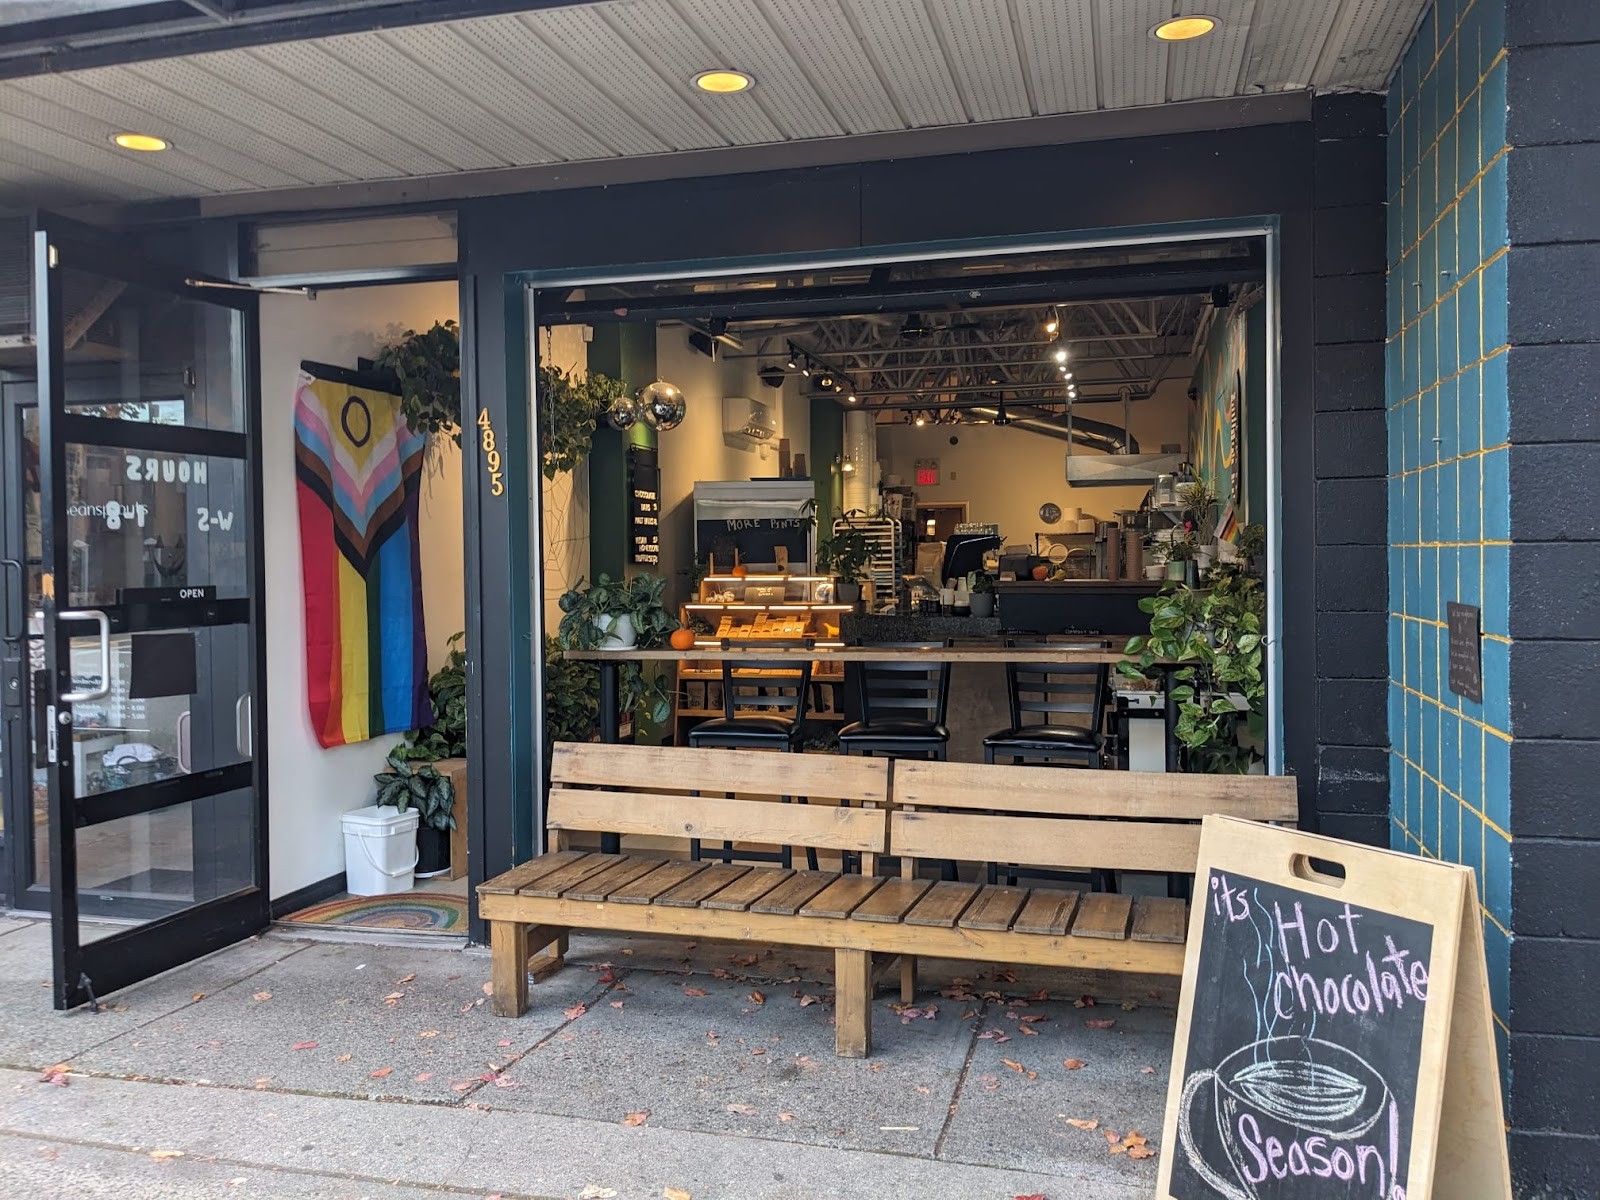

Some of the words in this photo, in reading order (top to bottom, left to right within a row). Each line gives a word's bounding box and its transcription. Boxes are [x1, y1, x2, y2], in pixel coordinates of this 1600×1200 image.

[477, 407, 504, 496] 4895
[917, 469, 937, 485] EXIT
[726, 519, 760, 532] MORE
[770, 518, 801, 530] PINTS
[180, 588, 205, 599] OPEN
[1210, 874, 1249, 922] its
[1274, 901, 1363, 964] Hot
[1274, 935, 1429, 1020] chocolate
[1238, 1101, 1408, 1200] Season!
